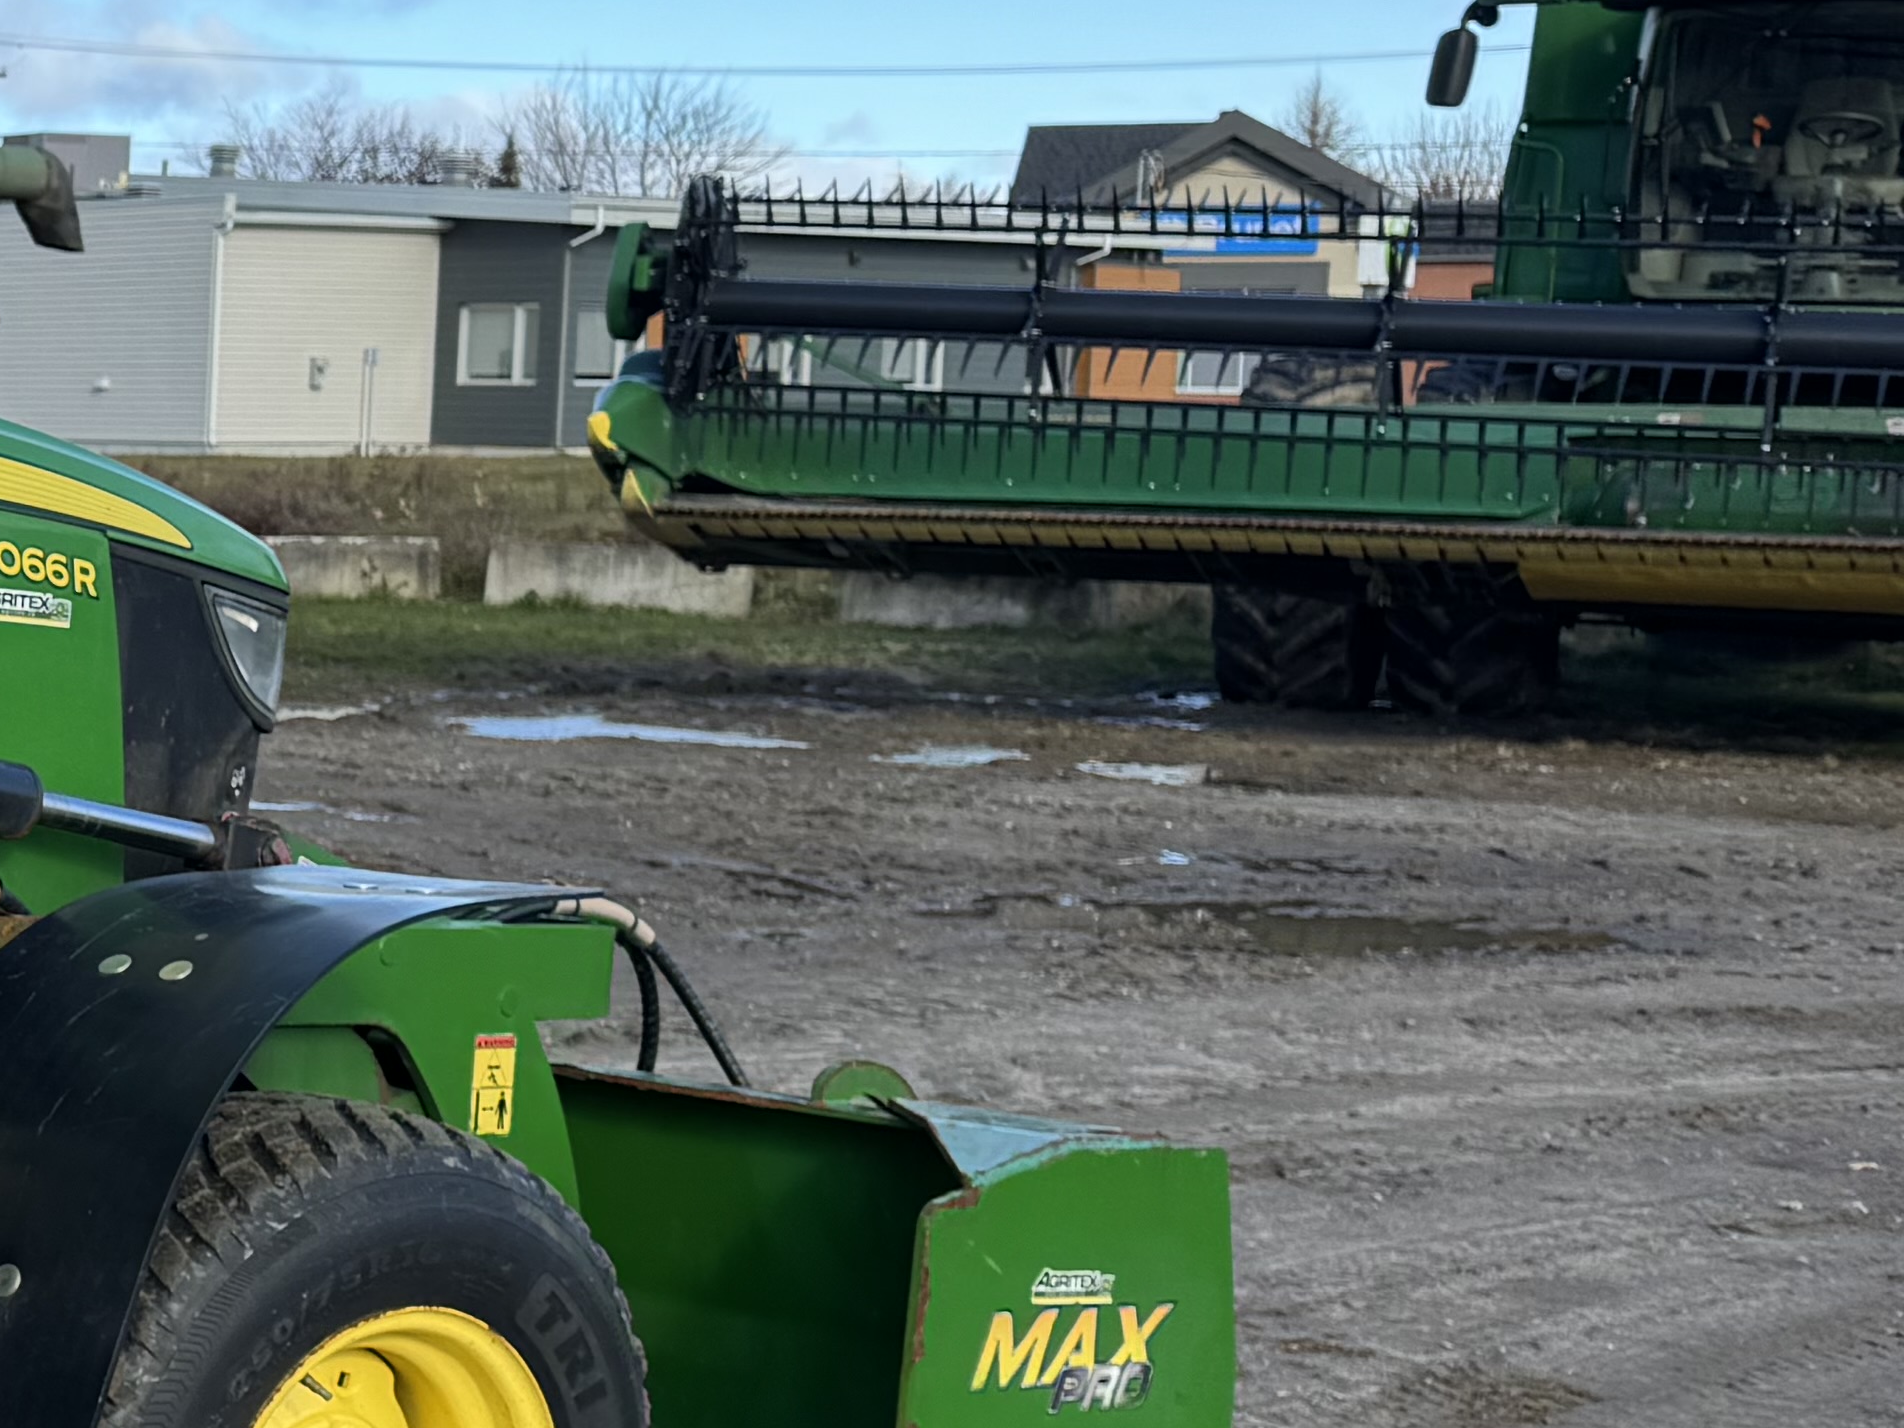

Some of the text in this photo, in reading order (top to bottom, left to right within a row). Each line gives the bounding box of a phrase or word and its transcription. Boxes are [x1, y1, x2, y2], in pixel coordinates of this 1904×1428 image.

[1036, 1270, 1099, 1289] AGRITEX
[532, 1289, 608, 1413] TRI
[970, 1302, 1176, 1392] MAX
